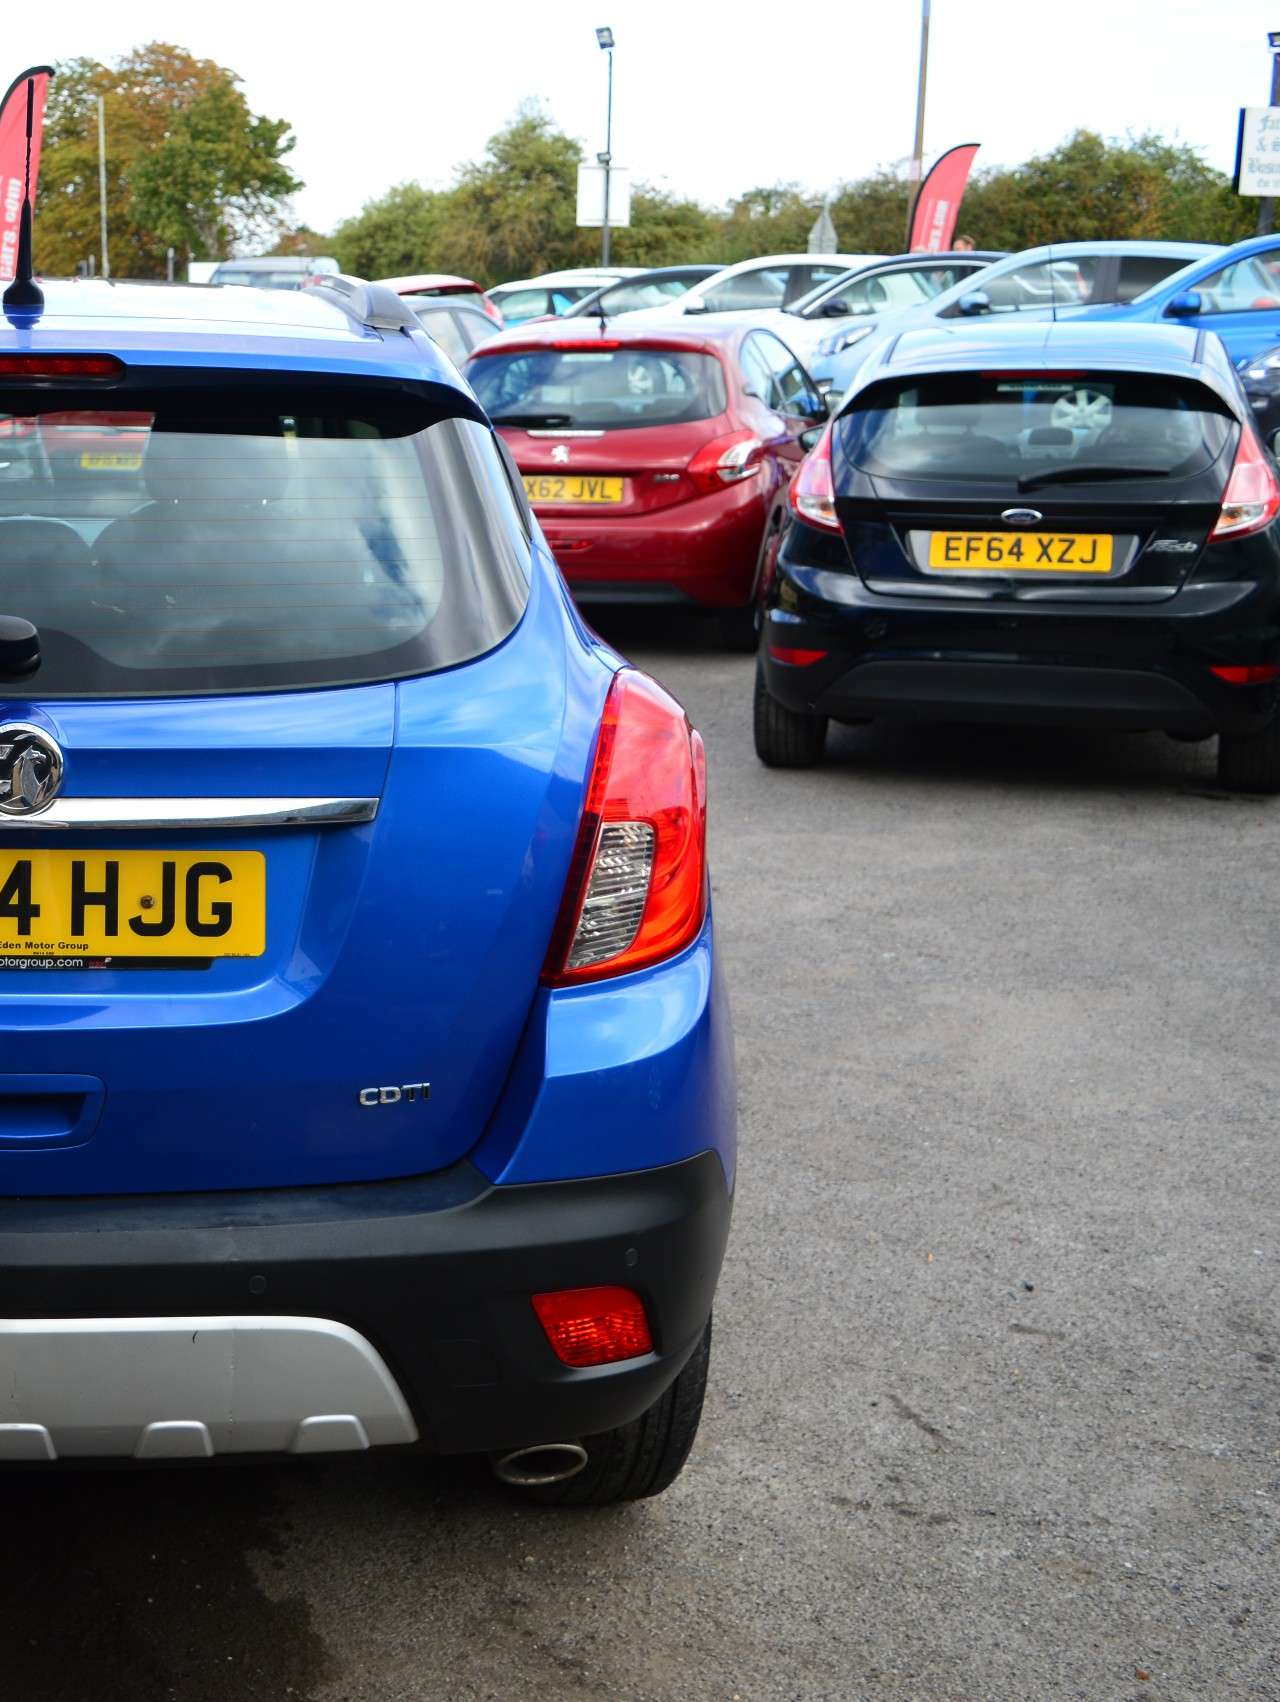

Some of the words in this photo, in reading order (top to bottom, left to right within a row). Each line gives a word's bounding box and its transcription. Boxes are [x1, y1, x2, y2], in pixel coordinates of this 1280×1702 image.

[526, 478, 563, 498] X62
[572, 478, 612, 499] JVL
[944, 536, 1024, 562] EF64
[1035, 538, 1097, 565] XZJ
[71, 860, 233, 937] HJG
[24, 941, 55, 950] Motor
[58, 941, 89, 951] Group
